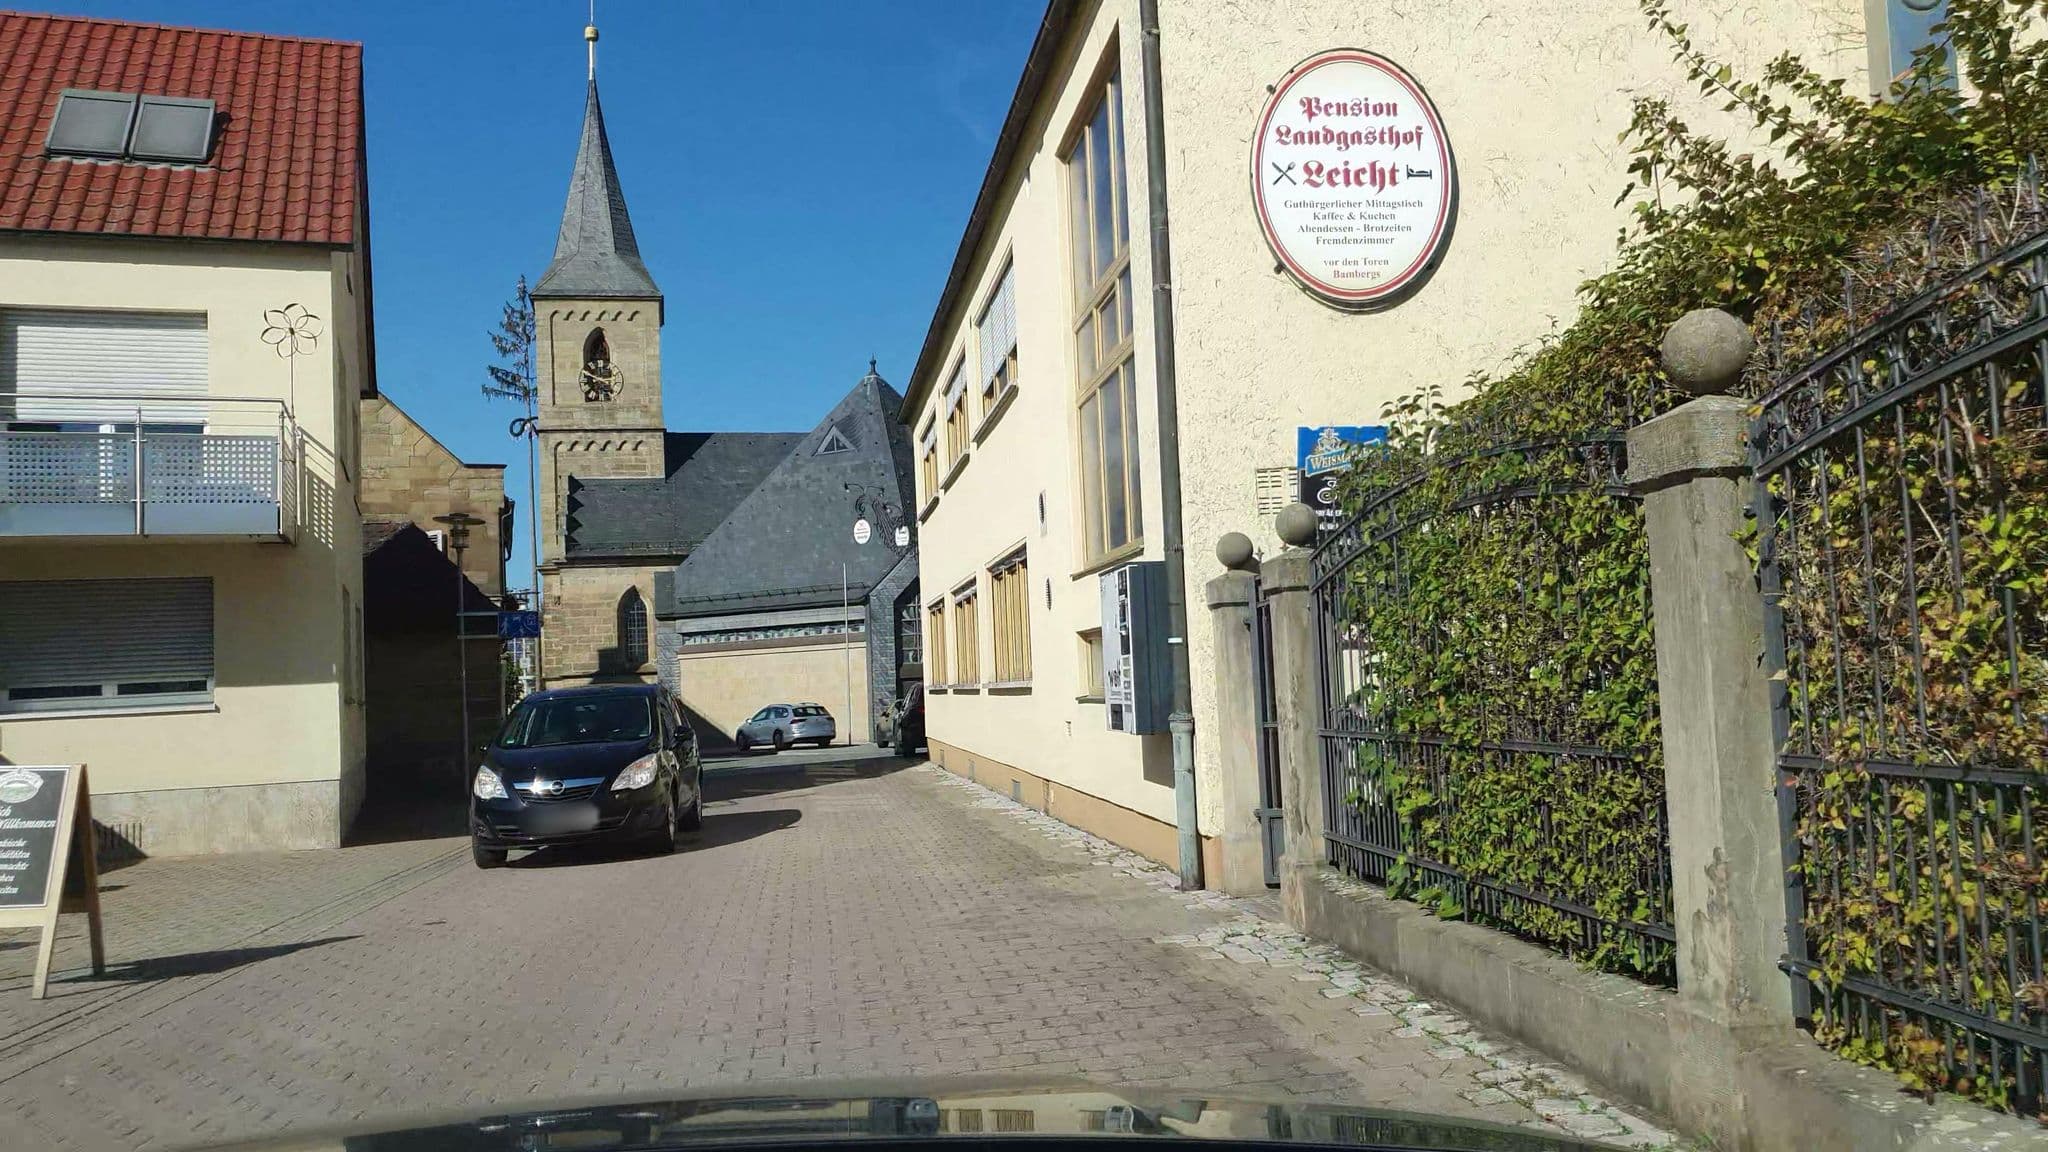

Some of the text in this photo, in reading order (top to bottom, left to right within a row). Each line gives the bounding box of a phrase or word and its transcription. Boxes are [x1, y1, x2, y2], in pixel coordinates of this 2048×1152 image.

[1299, 96, 1399, 123] Pension
[1275, 124, 1424, 152] Landgasthof
[1302, 160, 1400, 195] Leicht
[1365, 199, 1423, 210] Mittagstisch
[1313, 211, 1396, 221] Kaffee & Kuchen
[1297, 224, 1354, 233] Abendessen
[1363, 223, 1412, 233] Brotzeiten
[1316, 236, 1395, 246] Fremdenzimmer
[1342, 257, 1359, 266] den
[1362, 257, 1389, 266] Toren
[1333, 269, 1381, 279] Bambergs
